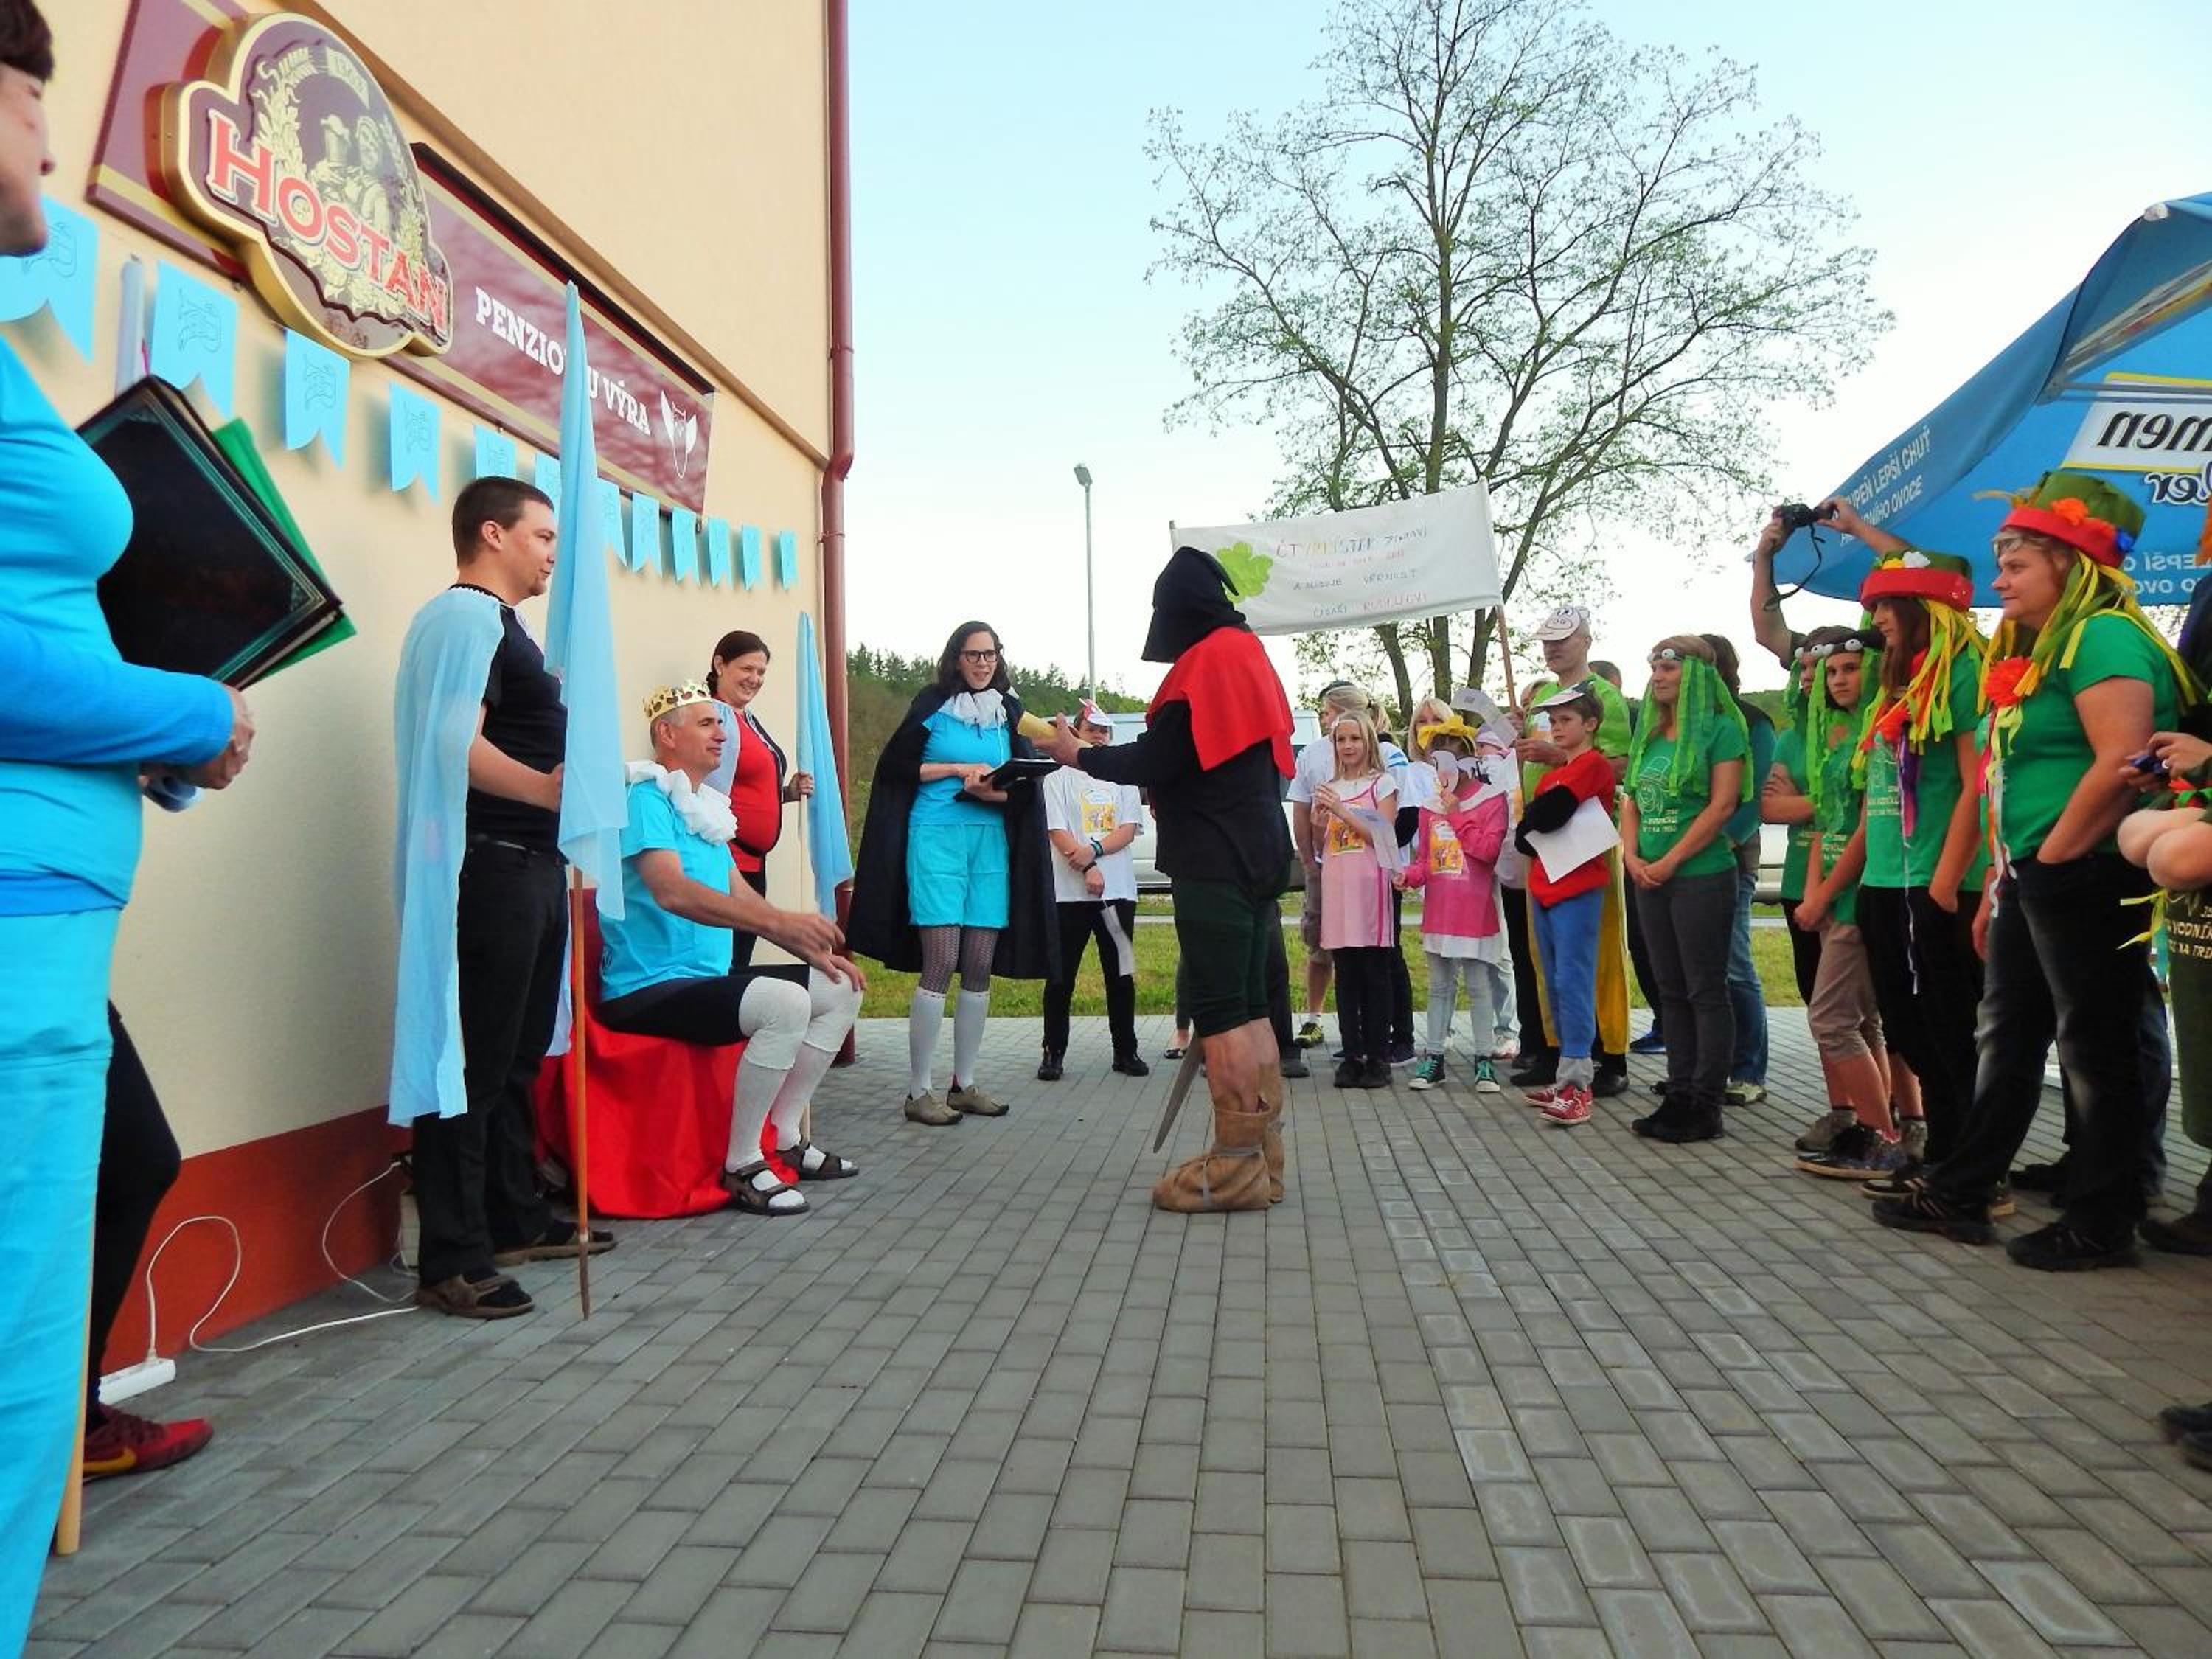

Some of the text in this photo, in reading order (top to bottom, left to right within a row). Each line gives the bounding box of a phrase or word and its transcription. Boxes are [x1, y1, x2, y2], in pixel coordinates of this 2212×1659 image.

[206, 109, 450, 343] HOSTAN
[476, 285, 566, 378] PENZIO
[602, 376, 651, 437] VÝRA
[1872, 449, 1902, 494] LEPŠÍ
[1901, 424, 1931, 471] CHUŤ
[1891, 474, 1923, 513] OVOCE
